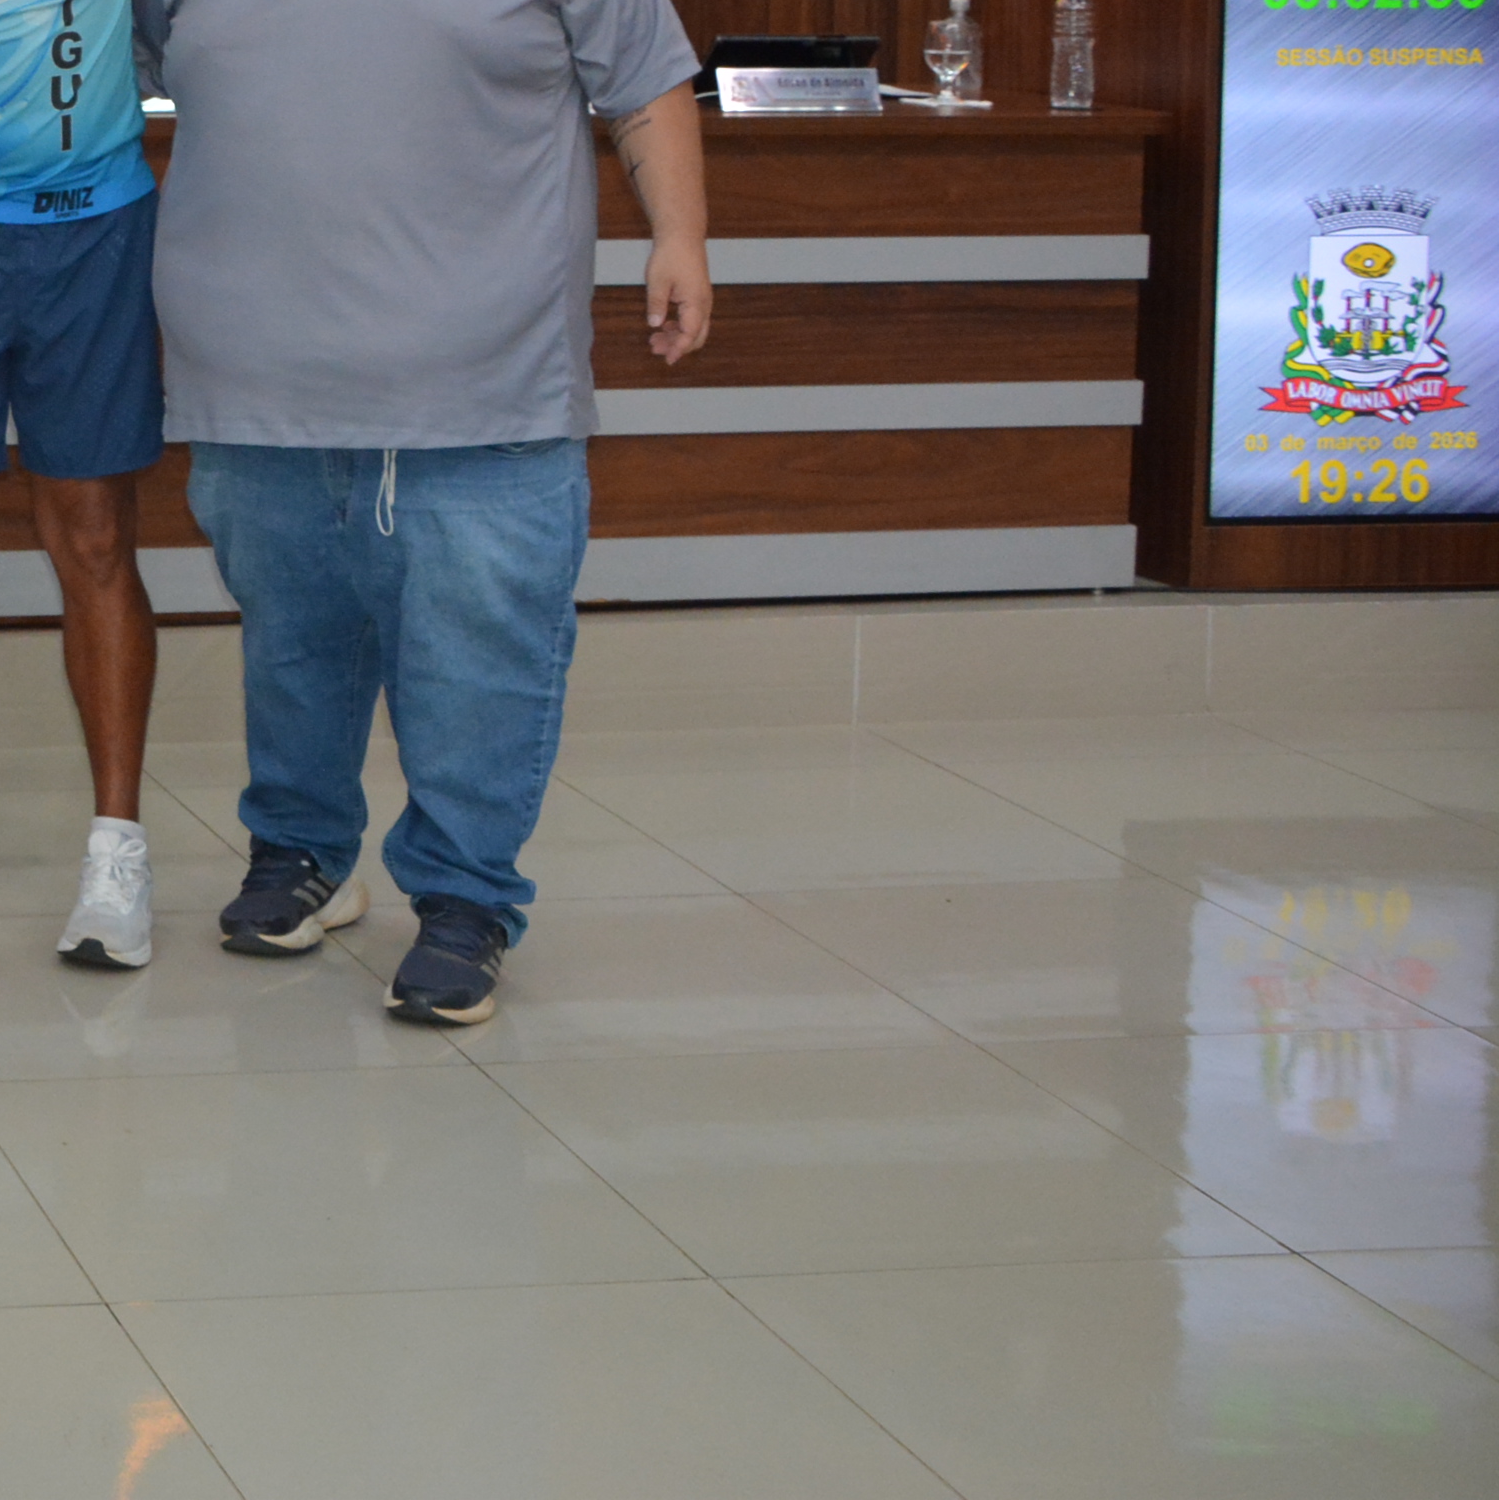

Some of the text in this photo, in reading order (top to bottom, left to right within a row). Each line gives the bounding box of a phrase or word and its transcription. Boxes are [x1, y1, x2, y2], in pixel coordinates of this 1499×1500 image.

[1276, 44, 1484, 67] SESSÃO SUSPENSA
[33, 186, 94, 214] DINIZ
[1287, 380, 1444, 410] LABOR OMNIA VINCIT
[1245, 431, 1478, 453] 03 de março de 2026
[1290, 459, 1430, 504] 19:26
